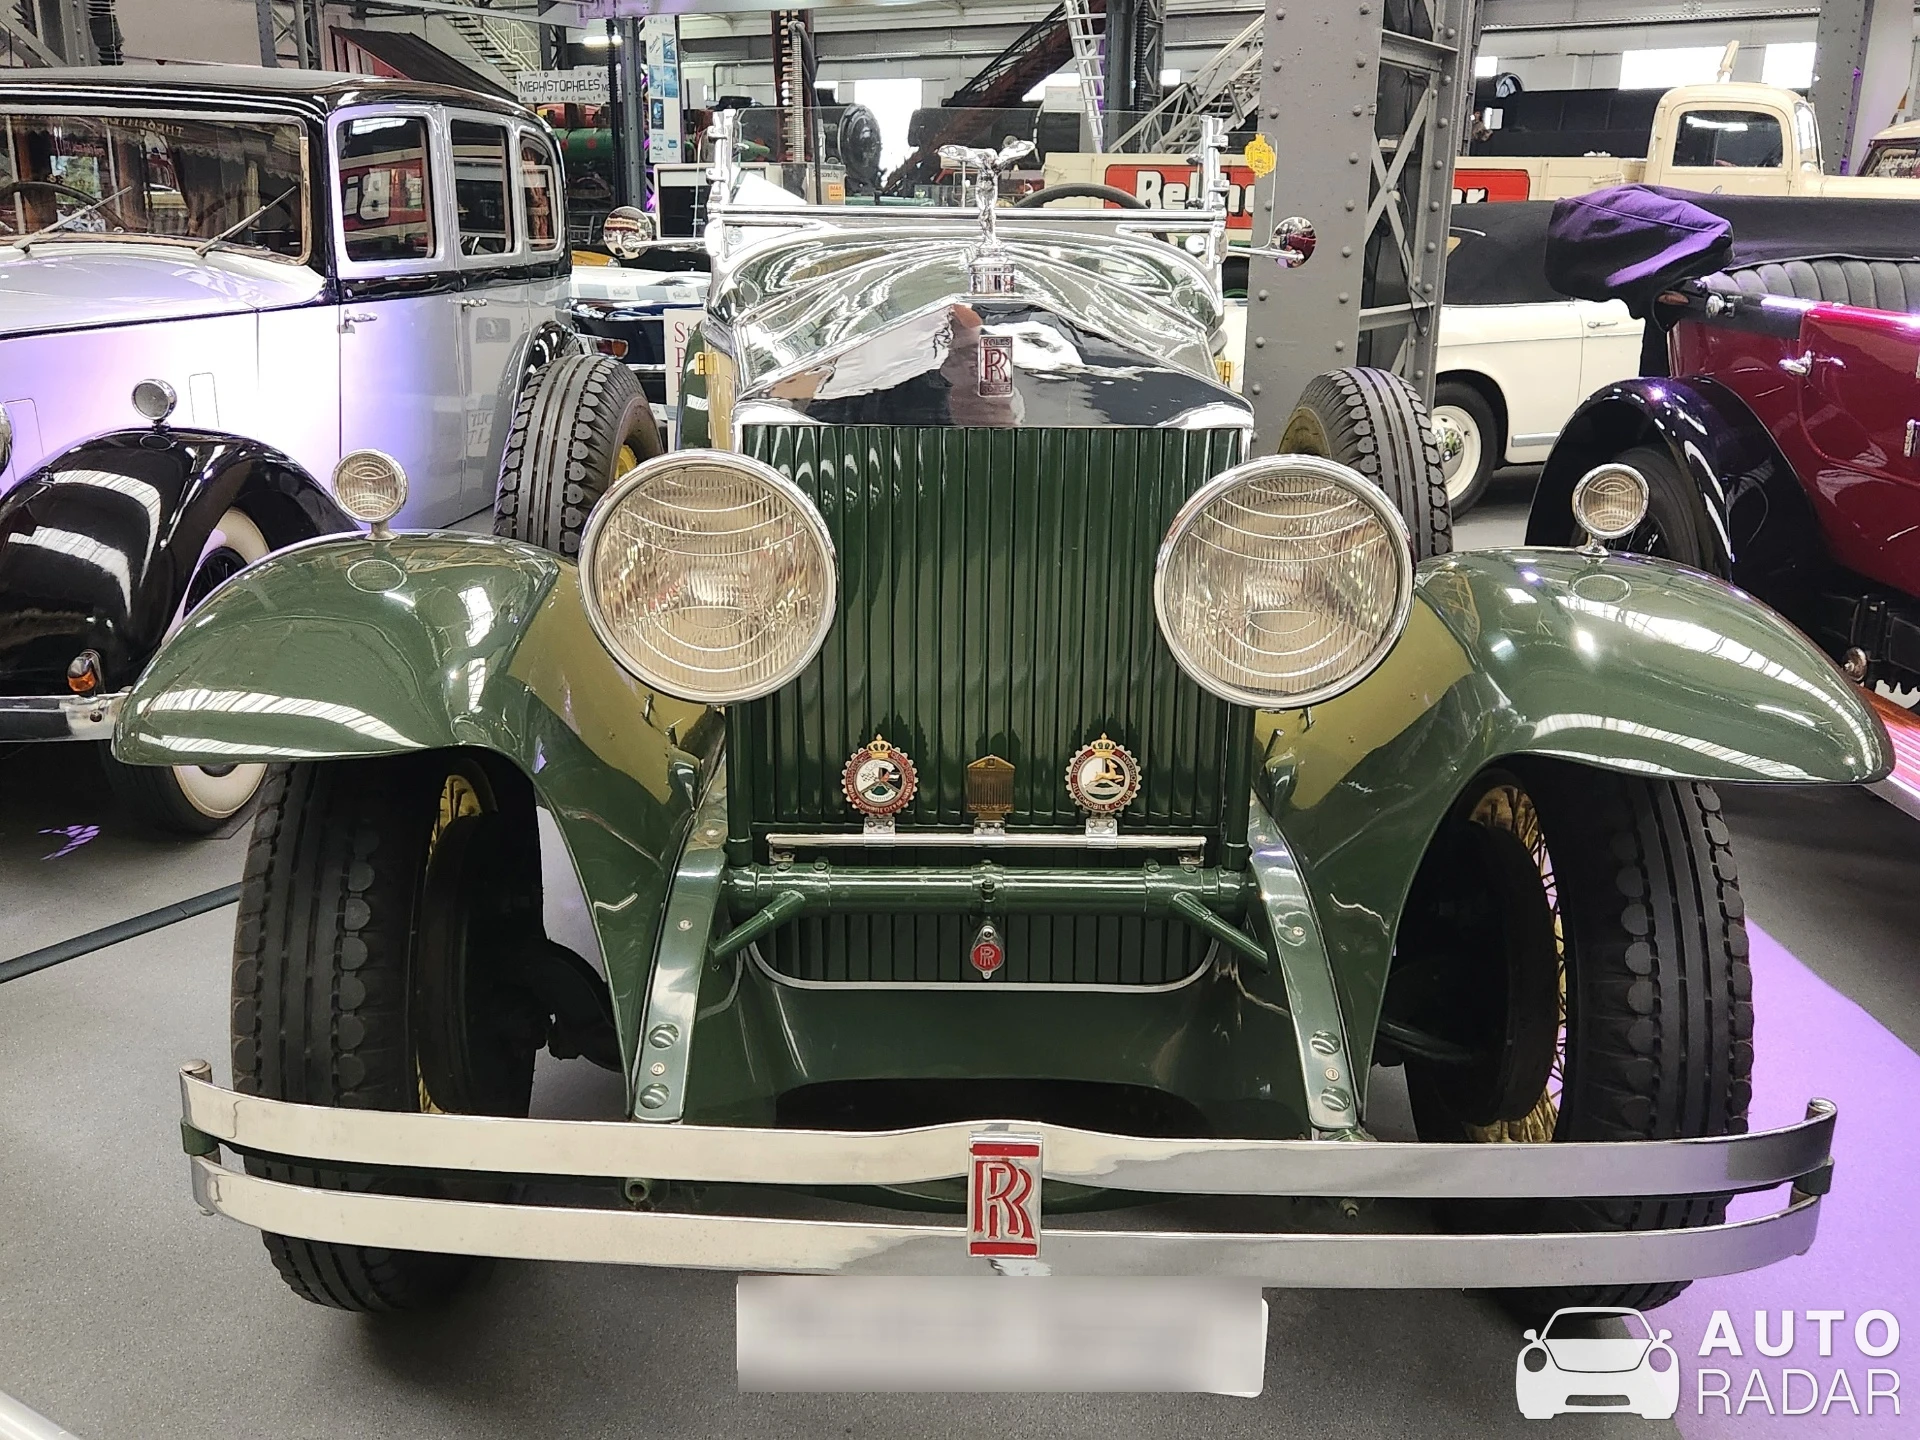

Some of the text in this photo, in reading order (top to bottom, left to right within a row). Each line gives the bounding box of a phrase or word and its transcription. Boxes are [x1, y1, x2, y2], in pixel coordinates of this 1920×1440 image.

[519, 79, 600, 92] MEPHISTOPHELES
[984, 348, 1009, 382] RR
[1071, 753, 1137, 811] ROYAL AUTOMOBILE CLUB JORDAN
[980, 946, 996, 967] RR
[973, 1160, 1035, 1240] RR
